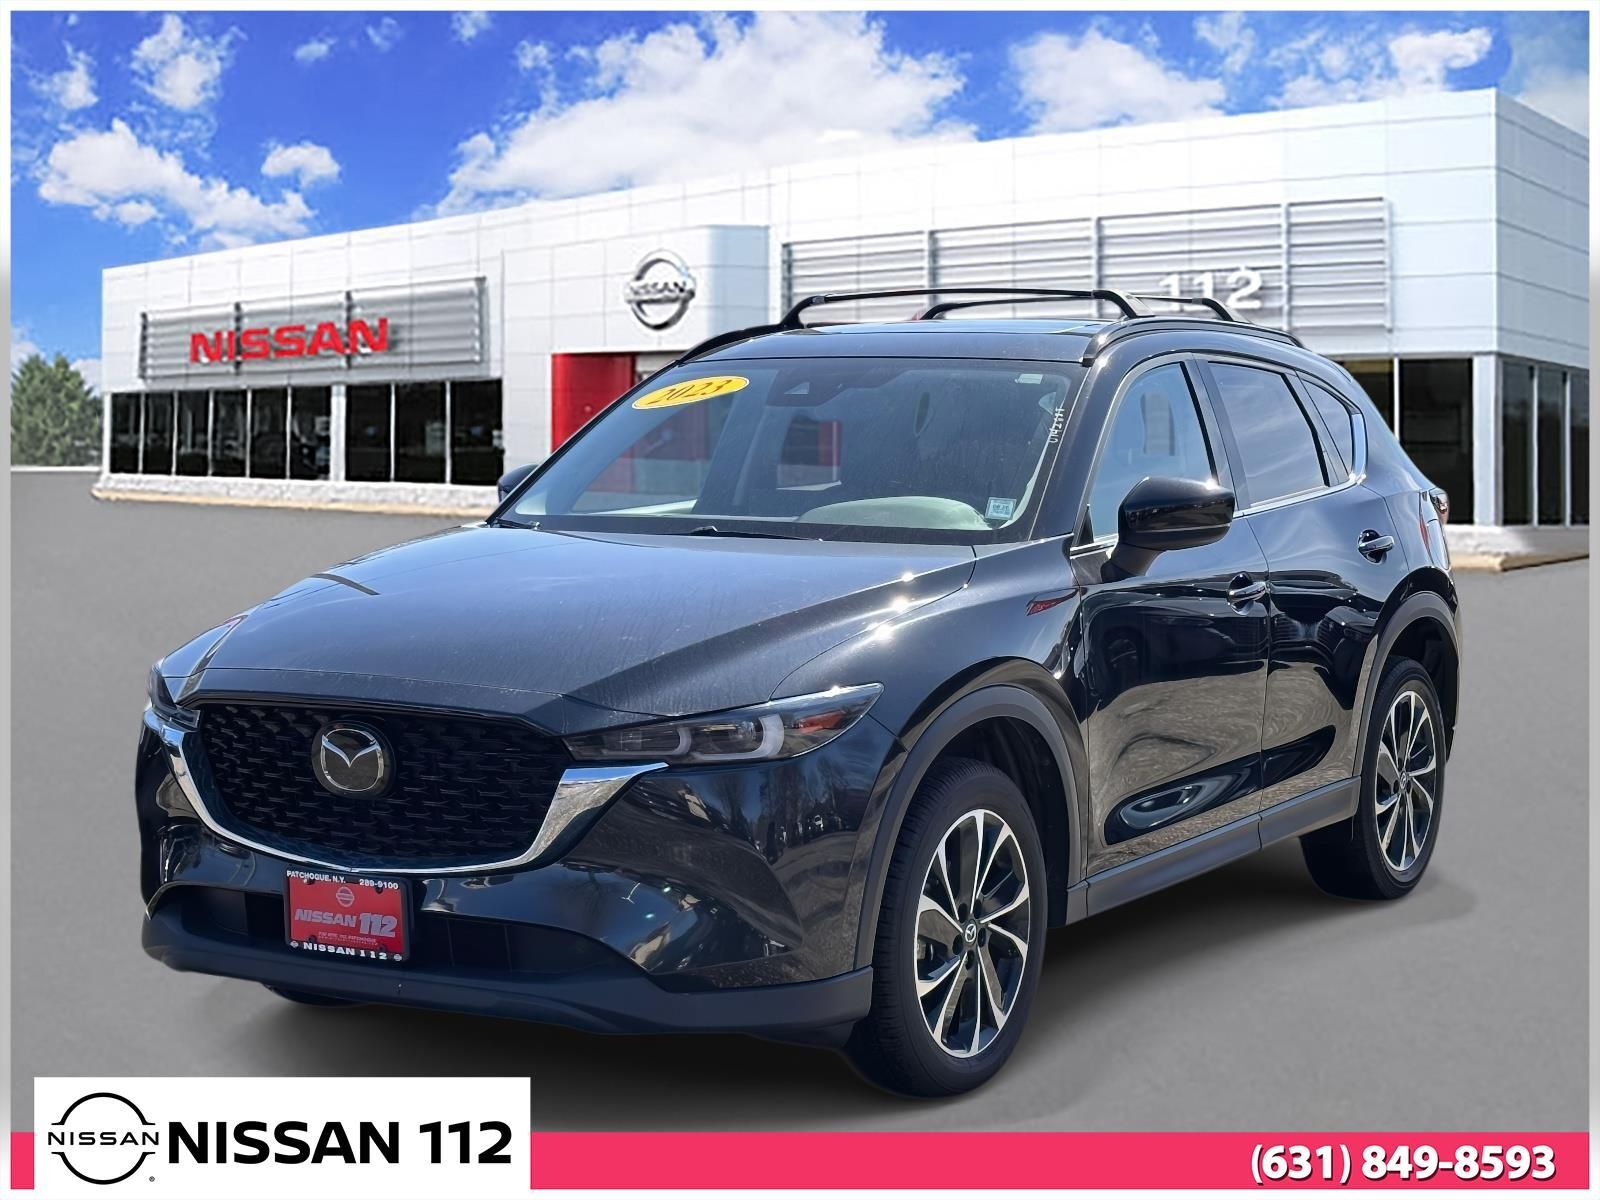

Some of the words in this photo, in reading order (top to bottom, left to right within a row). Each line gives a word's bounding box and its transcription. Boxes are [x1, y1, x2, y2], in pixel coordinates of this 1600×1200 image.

[628, 281, 688, 297] NISSAN
[1158, 266, 1263, 312] 112
[190, 317, 388, 364] NISSAN
[647, 379, 733, 405] 2023
[332, 875, 346, 884] N.Y.
[294, 908, 357, 928] NISSAN
[359, 912, 398, 938] 112
[303, 942, 356, 956] NISSAN
